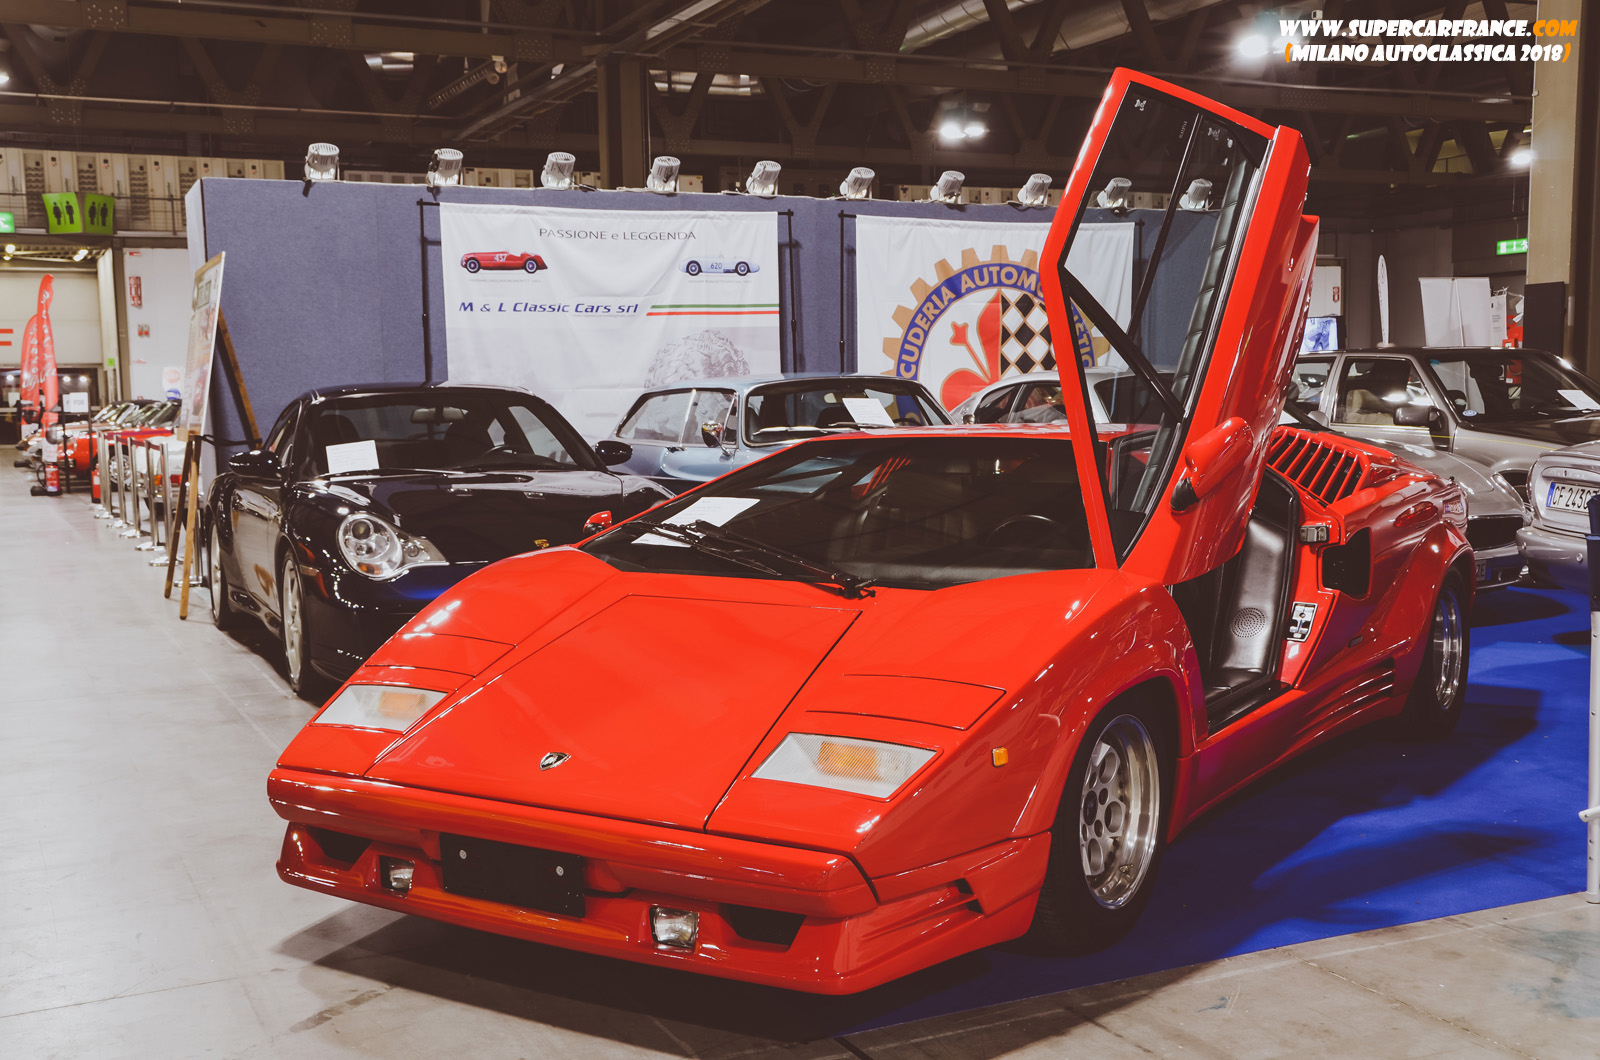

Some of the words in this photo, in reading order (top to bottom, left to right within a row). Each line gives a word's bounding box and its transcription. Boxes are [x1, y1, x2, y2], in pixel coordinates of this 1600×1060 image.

[539, 228, 607, 240] PASSIONE
[611, 231, 619, 240] e
[623, 231, 697, 241] LEGGENDA
[710, 262, 722, 270] 620
[459, 302, 474, 312] M
[480, 303, 491, 312] &
[498, 302, 506, 312] L
[512, 302, 570, 313] Classic
[574, 303, 611, 313] Cars
[616, 303, 639, 313] srl
[900, 286, 956, 379] CUDERIA
[1552, 485, 1566, 506] CF
